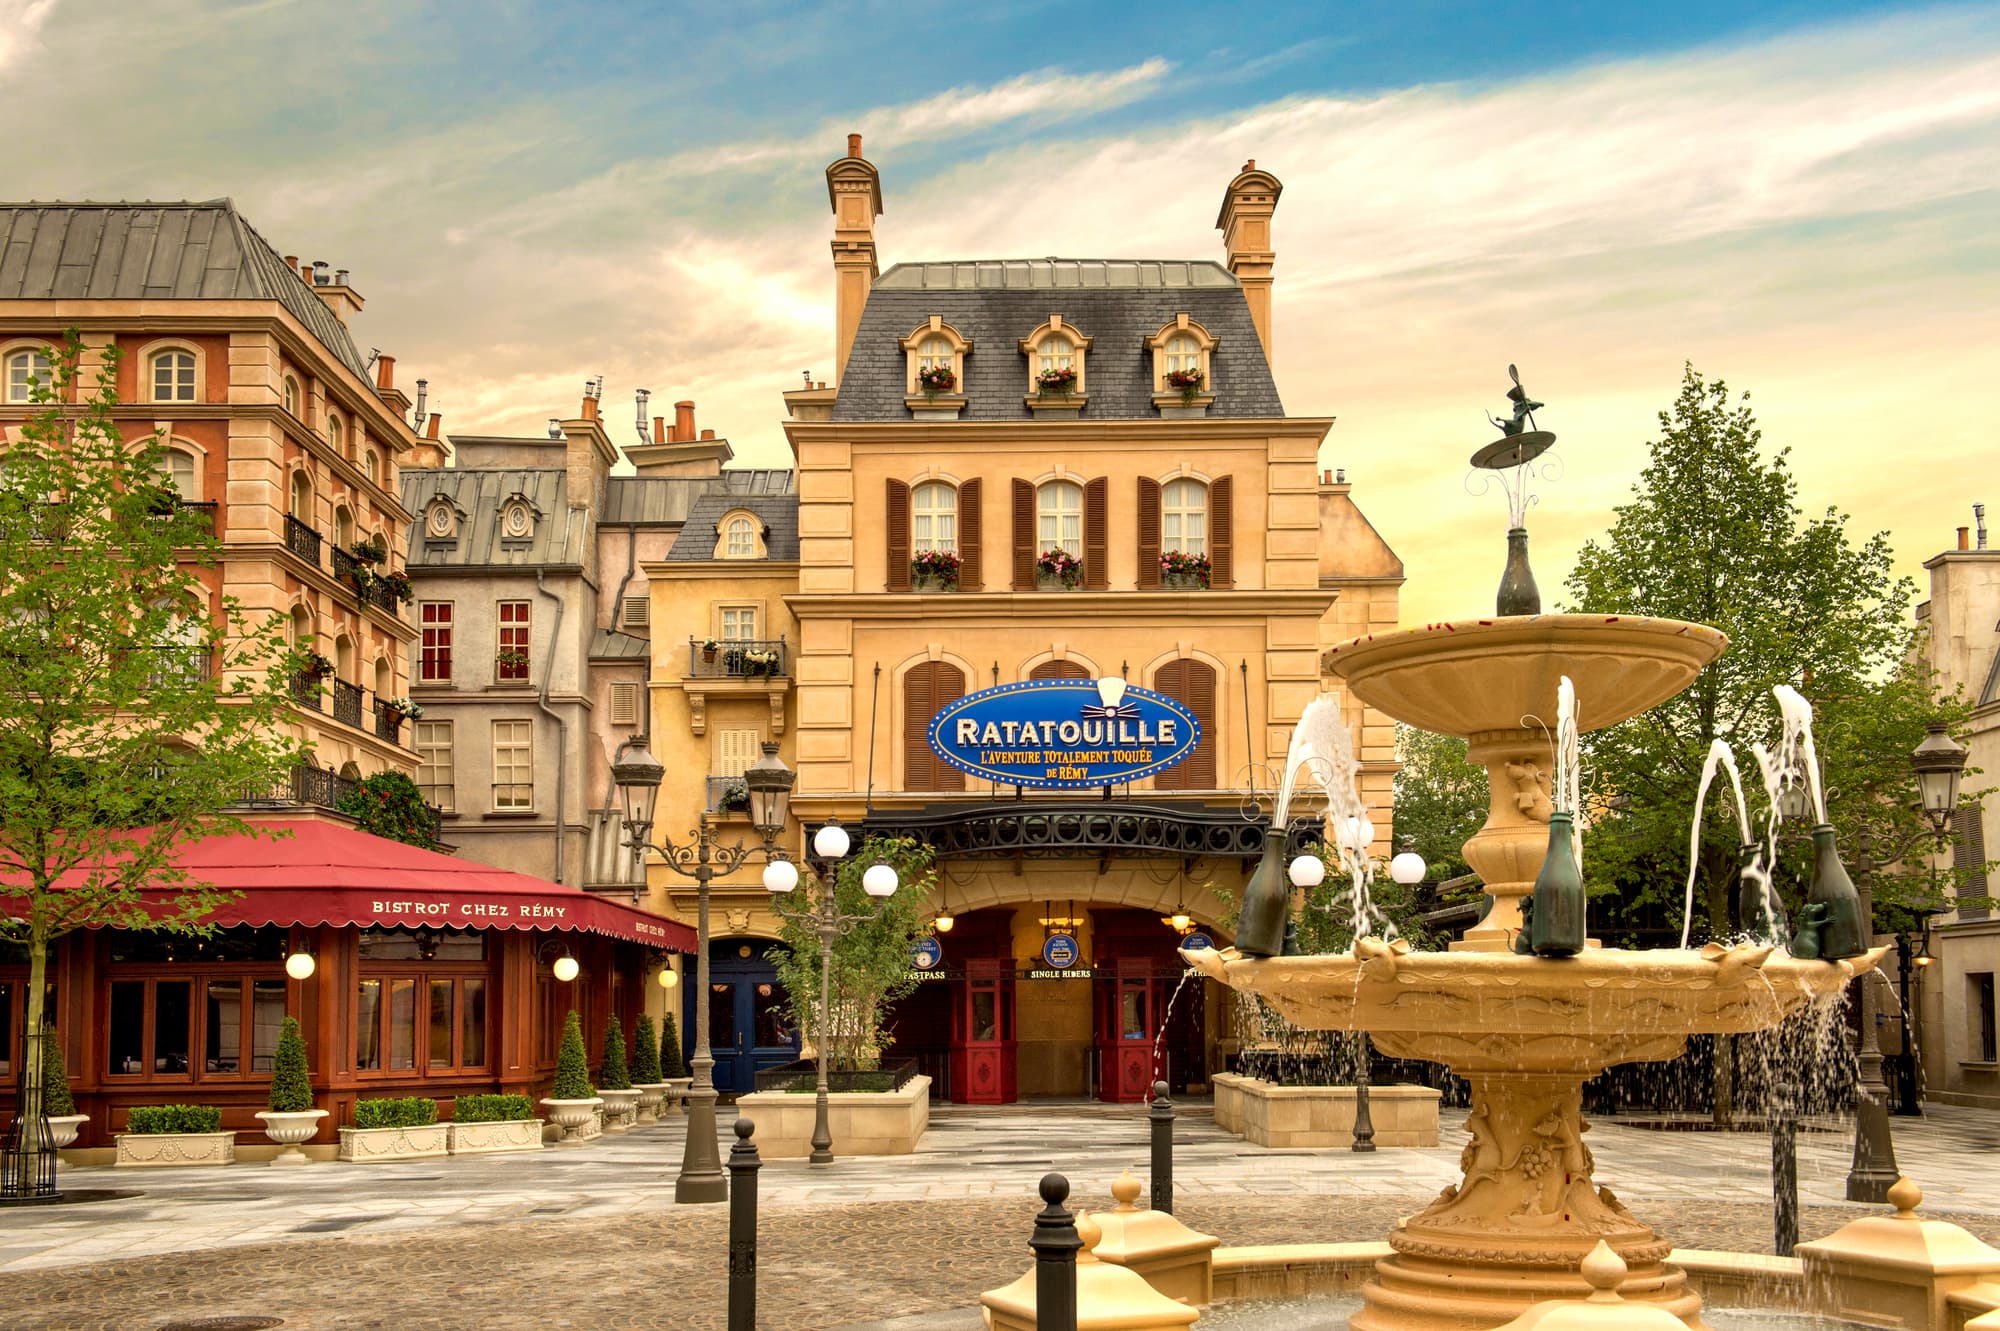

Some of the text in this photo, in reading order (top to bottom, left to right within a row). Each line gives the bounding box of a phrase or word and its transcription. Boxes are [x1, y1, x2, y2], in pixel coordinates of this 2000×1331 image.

[956, 718, 1176, 747] RATATOUILLE
[981, 747, 1153, 764] L'AVENTURE TOTALEMENT TOQUÉE
[1046, 764, 1088, 780] DE RÉMY
[372, 901, 566, 918] BISTROT CHEZ RÉMY
[1031, 970, 1091, 978] SINGLE RIDERS
